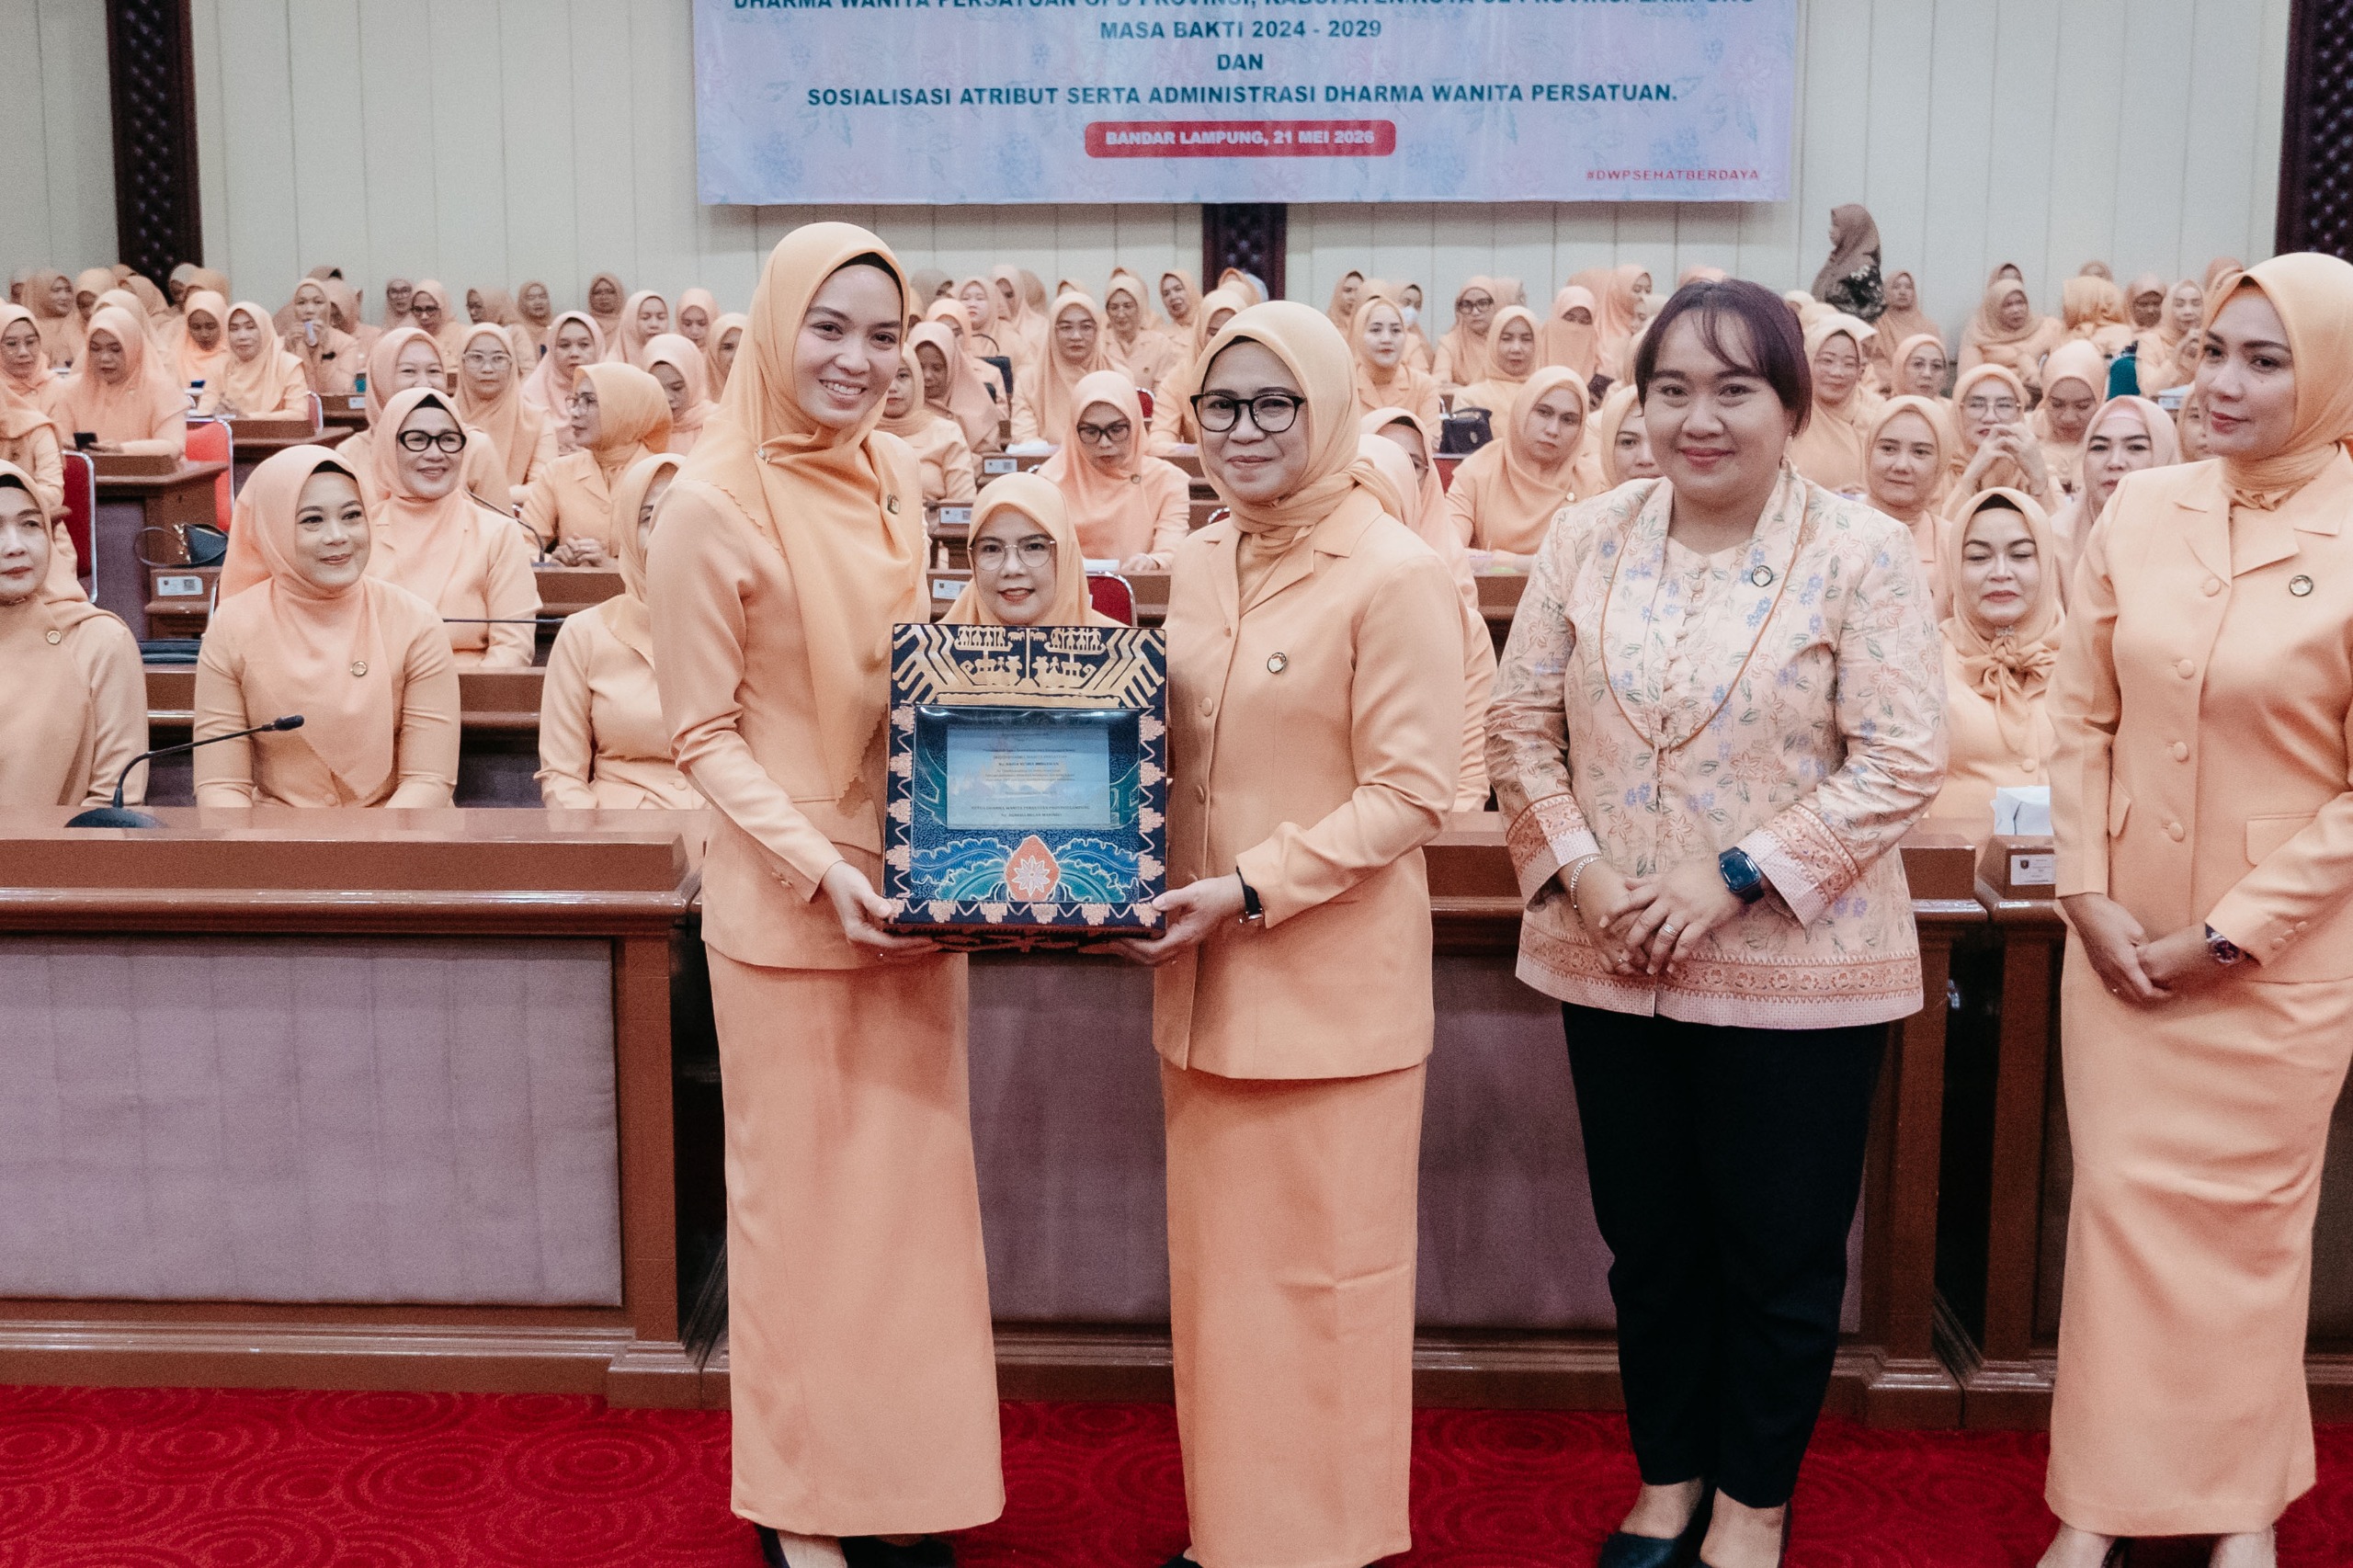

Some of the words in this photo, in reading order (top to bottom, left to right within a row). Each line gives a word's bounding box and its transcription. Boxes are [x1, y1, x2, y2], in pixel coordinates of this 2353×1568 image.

[1100, 21, 1165, 40] MASA
[1174, 20, 1244, 39] BAKTI
[1252, 20, 1306, 38] 2024
[1327, 20, 1382, 38] 2029
[1216, 52, 1264, 72] DAN
[807, 88, 951, 107] SOSIALISASI
[960, 87, 1059, 105] ATRIBUT
[1066, 86, 1142, 105] SERTA
[1148, 85, 1316, 104] ADMINISTRASI
[1324, 85, 1424, 103] DHARMA
[1432, 85, 1523, 102] WANITA
[1531, 84, 1677, 102] PERSATUAN.
[1106, 131, 1176, 145] BANDAR
[1179, 130, 1269, 146] LAMPUNG,
[1273, 130, 1293, 144] 21
[1298, 130, 1330, 144] MEI
[1334, 130, 1375, 144] 2026
[1586, 169, 1759, 181] #DWPSEHATBERDAYA
